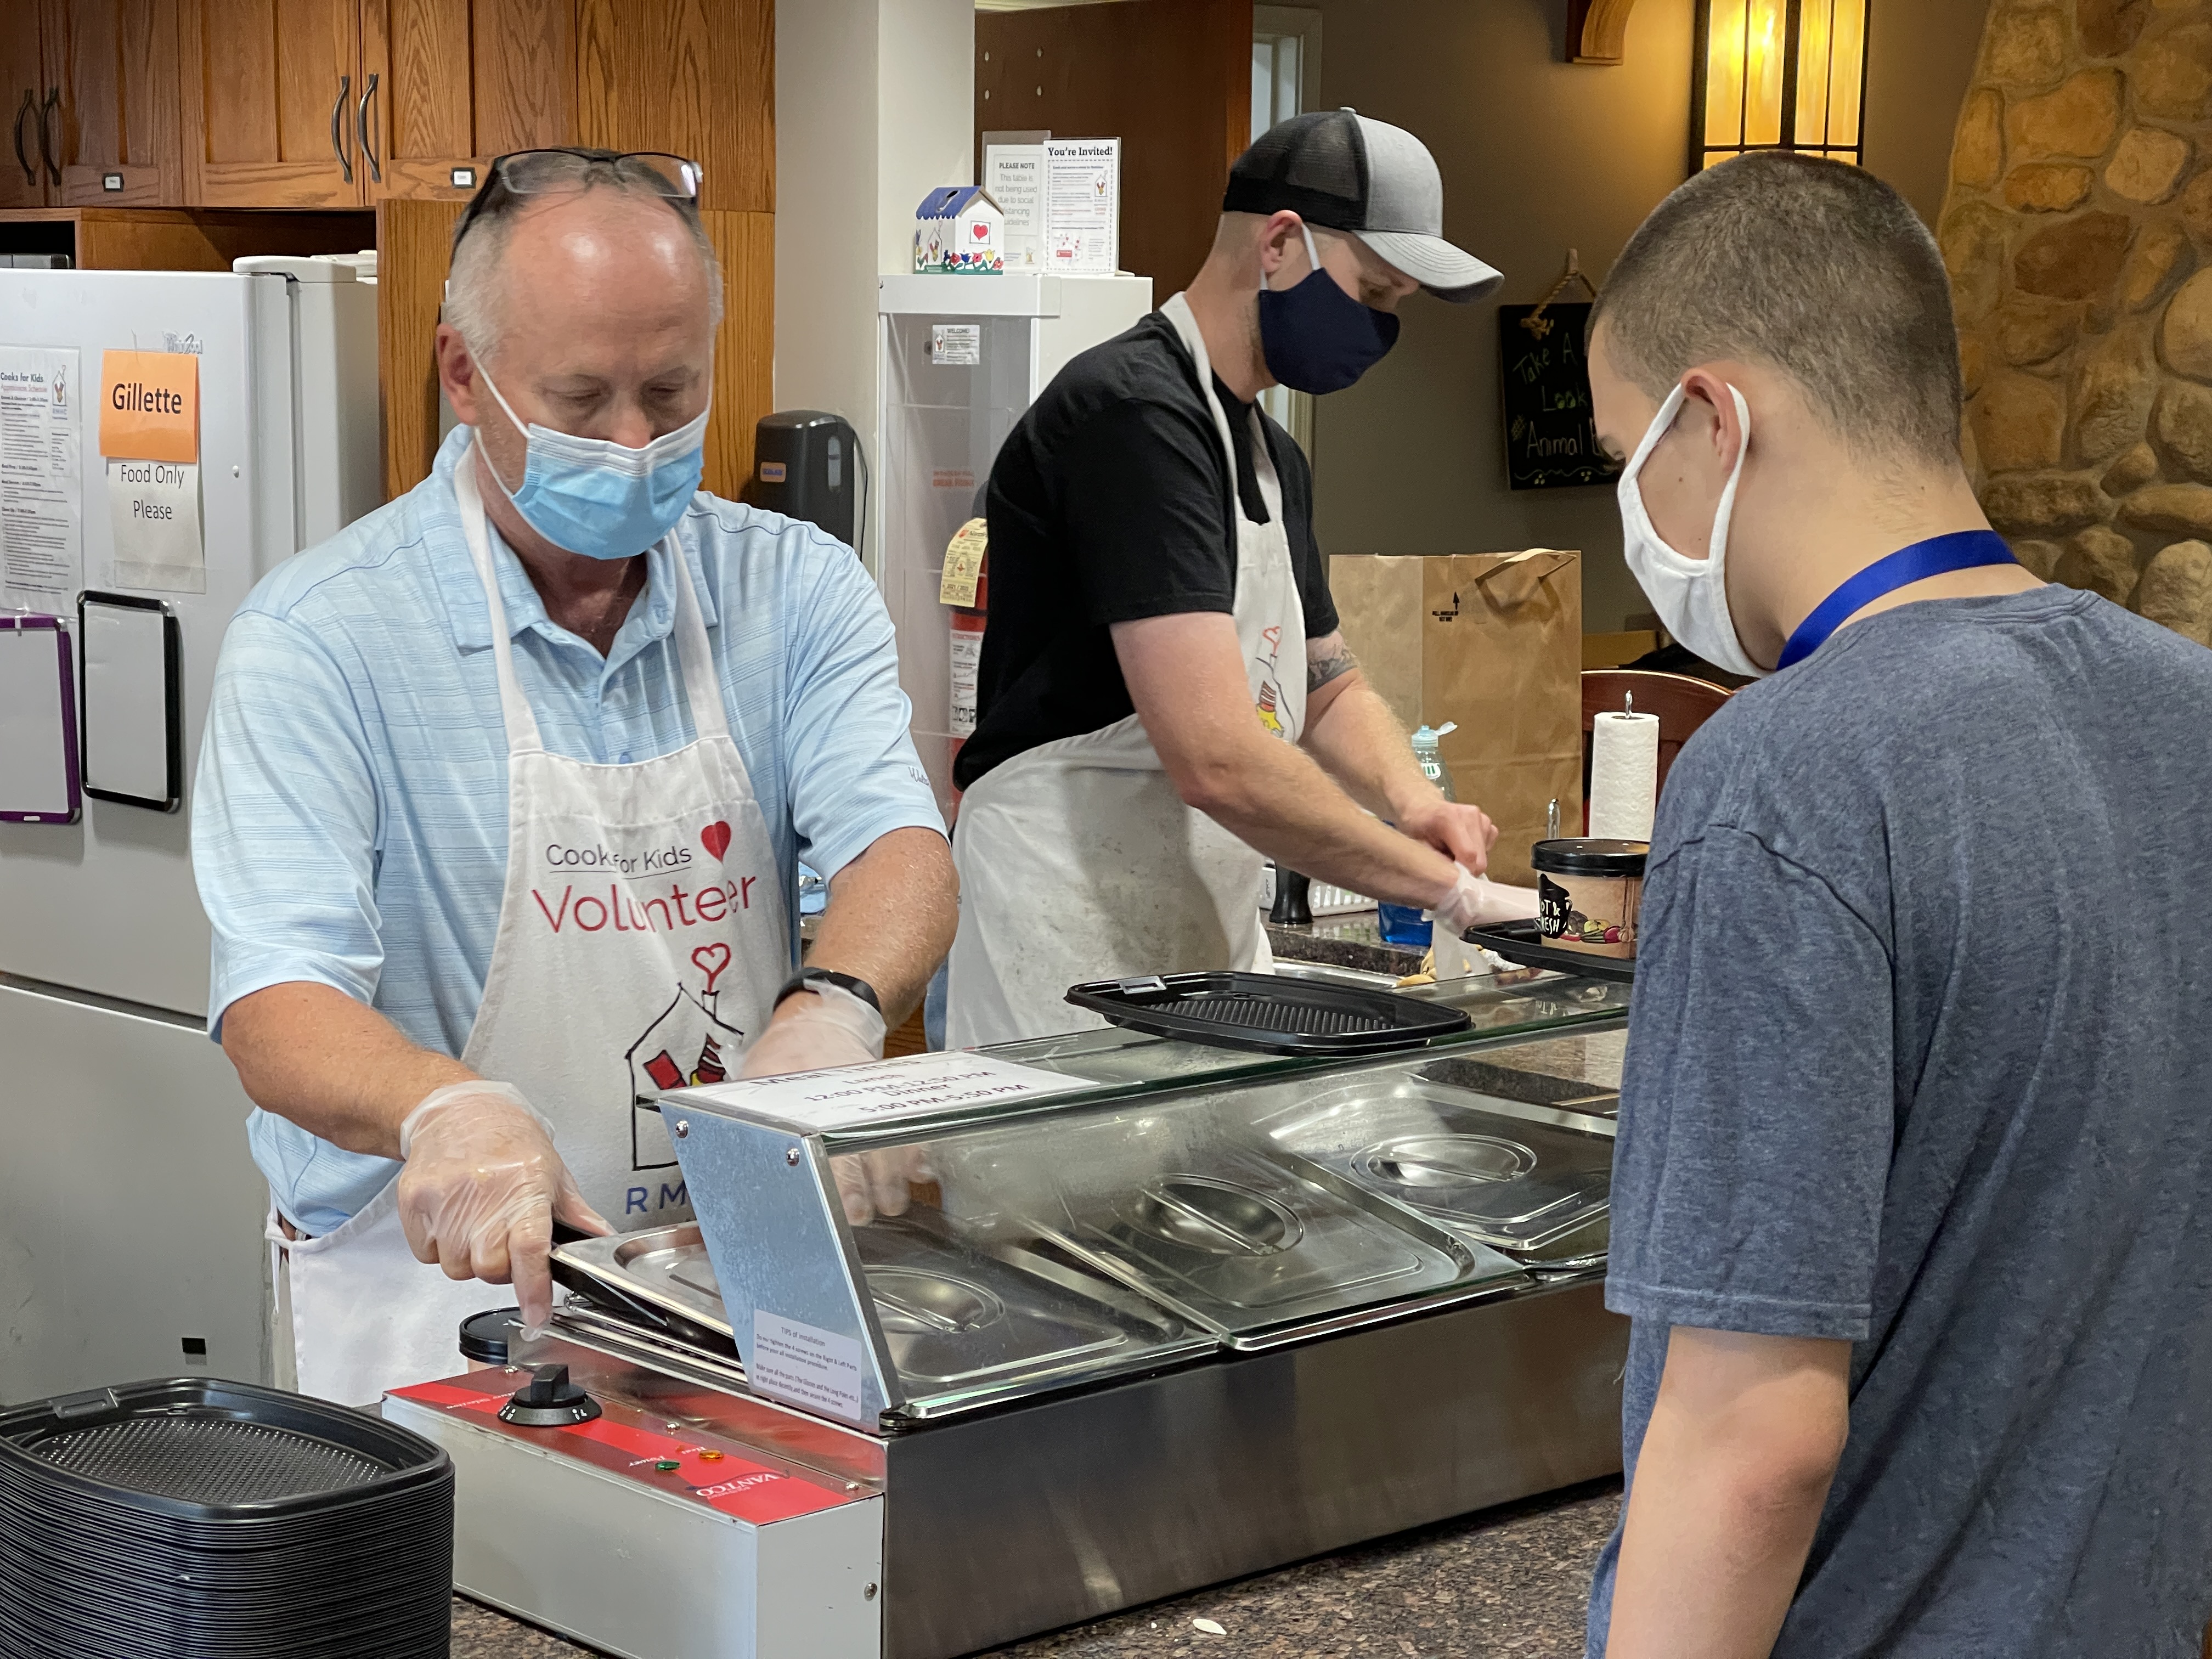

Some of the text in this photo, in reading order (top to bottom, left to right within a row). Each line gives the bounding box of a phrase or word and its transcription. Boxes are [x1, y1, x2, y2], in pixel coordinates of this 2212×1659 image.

[1048, 146, 1113, 156] You're Invited!
[1006, 185, 1022, 194] being
[1004, 207, 1030, 217] istancing
[1513, 332, 1578, 385] Take A
[112, 382, 182, 415] Gillette
[1541, 382, 1588, 411] Look
[1526, 419, 1583, 459] Animal
[121, 464, 185, 490] Food Only
[133, 499, 173, 520] Please
[644, 845, 692, 870] Kids
[531, 876, 757, 933] Volunteer
[1541, 899, 1561, 916] OT &
[751, 1060, 921, 1086] Meal Times
[842, 1074, 905, 1085] Lunch
[804, 1090, 863, 1101] 12:00
[859, 1102, 907, 1113] 5:00
[992, 1084, 1030, 1093] PM
[882, 1084, 951, 1096] Dinner
[626, 1180, 687, 1215] RM
[696, 1473, 780, 1497] VANTCO
